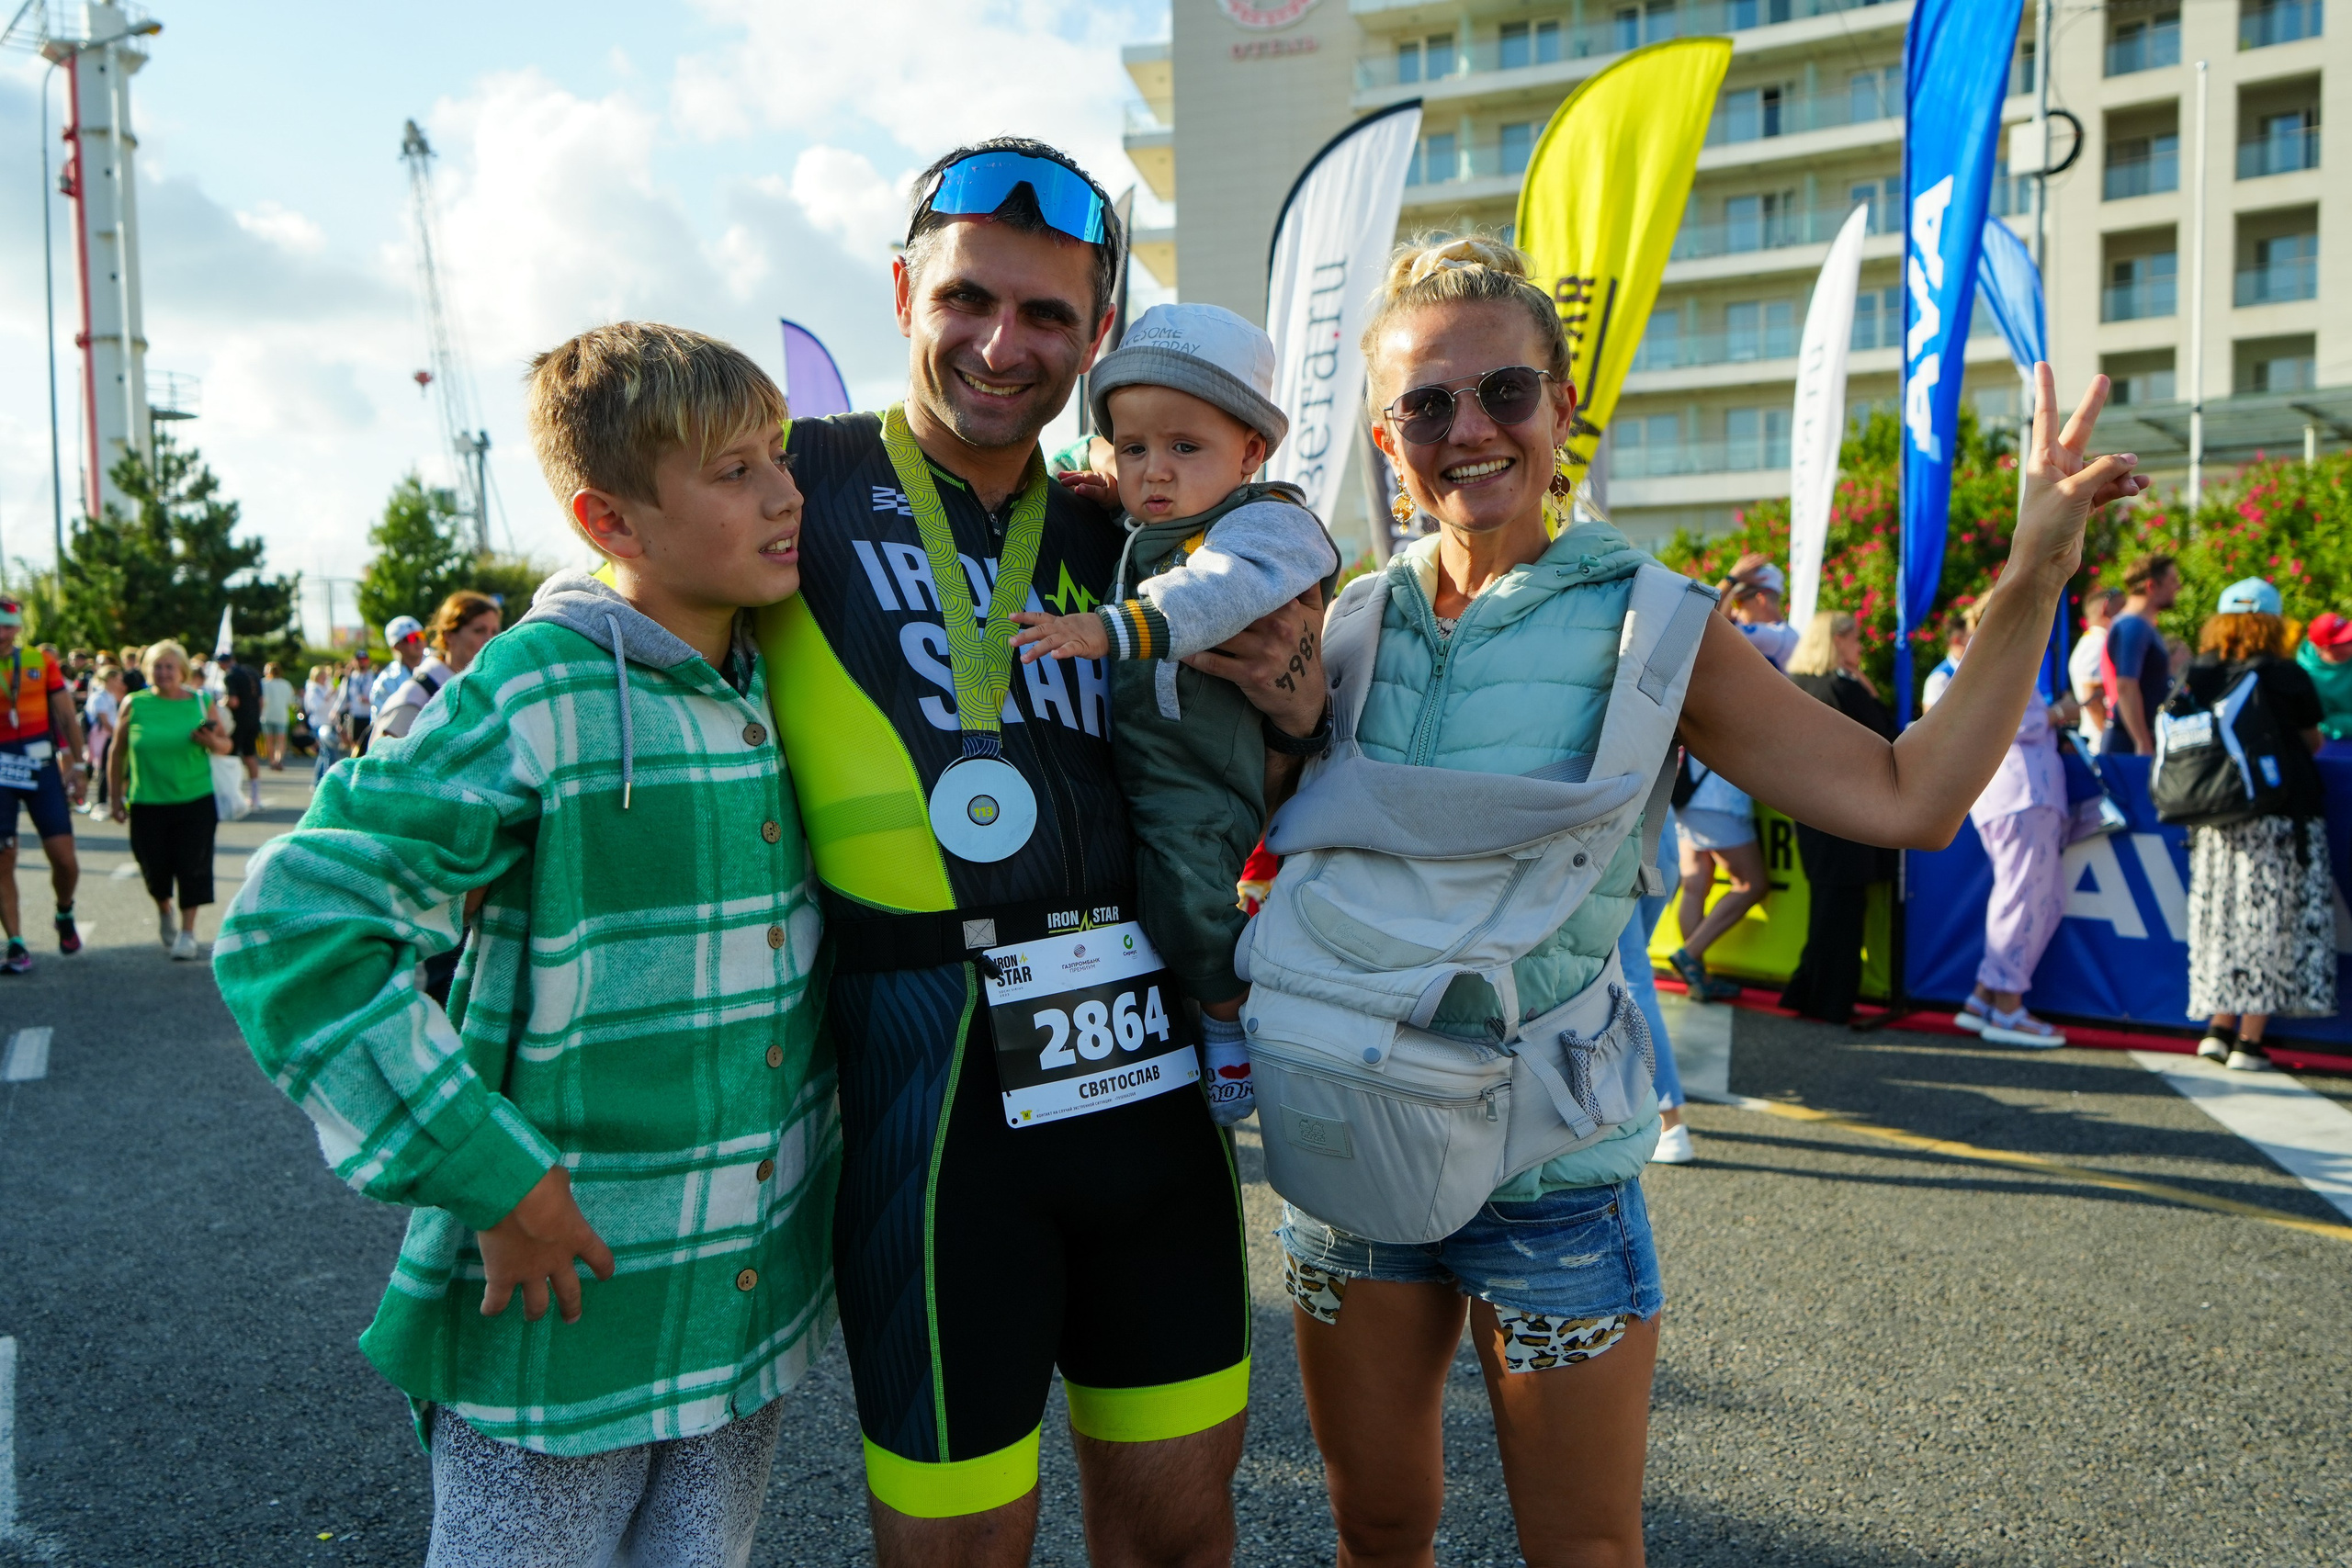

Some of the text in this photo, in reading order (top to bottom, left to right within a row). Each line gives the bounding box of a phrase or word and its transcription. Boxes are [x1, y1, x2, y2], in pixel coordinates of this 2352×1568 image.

[974, 807, 994, 818] 113
[1047, 906, 1119, 929] IRON STAR
[1062, 957, 1101, 970] ГАЗПРОМБАНК
[1069, 964, 1096, 974] ПРЕМИУМ
[997, 966, 1032, 987] STAR
[1033, 985, 1170, 1070] 2864
[1079, 1065, 1160, 1100] СВЯТОСЛАВ
